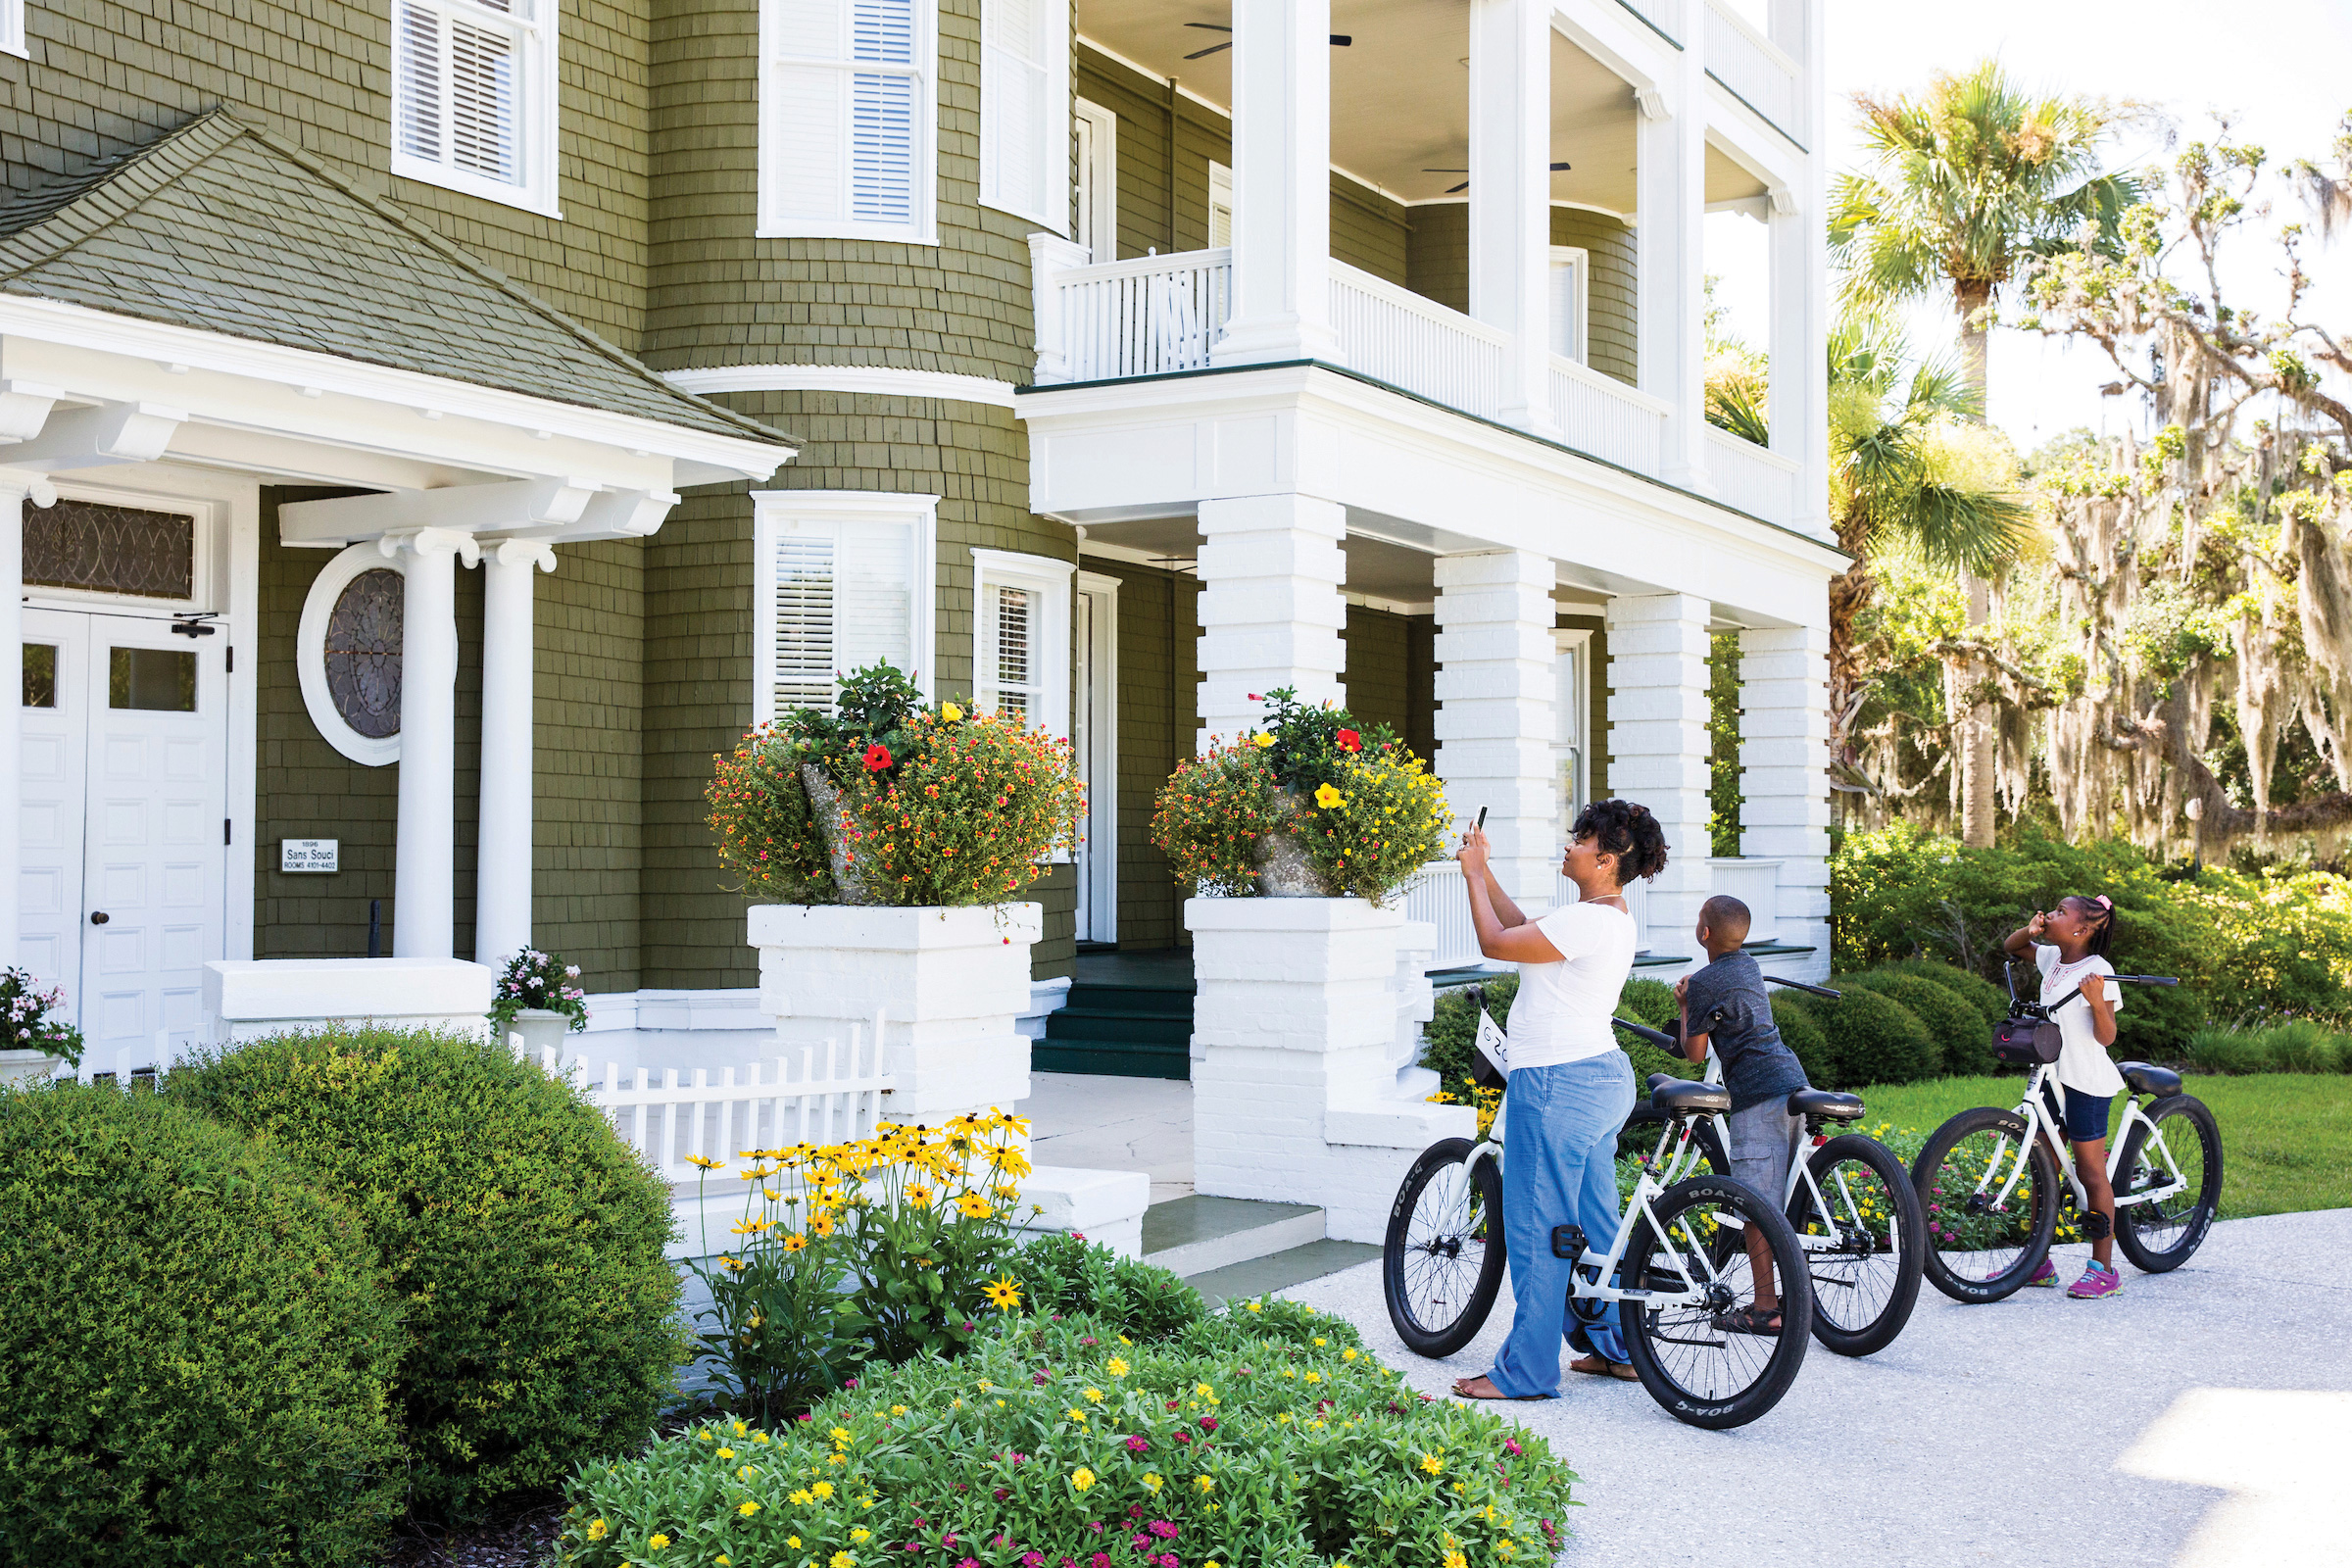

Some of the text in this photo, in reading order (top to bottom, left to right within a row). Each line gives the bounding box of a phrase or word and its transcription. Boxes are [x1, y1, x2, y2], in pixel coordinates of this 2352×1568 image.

[287, 849, 334, 860] Sans Souci
[1394, 1162, 1424, 1218] BOA-G
[1688, 1188, 1745, 1206] BOA-G
[1944, 1273, 1988, 1296] BOA-G
[1675, 1399, 1735, 1417] BOA-G
